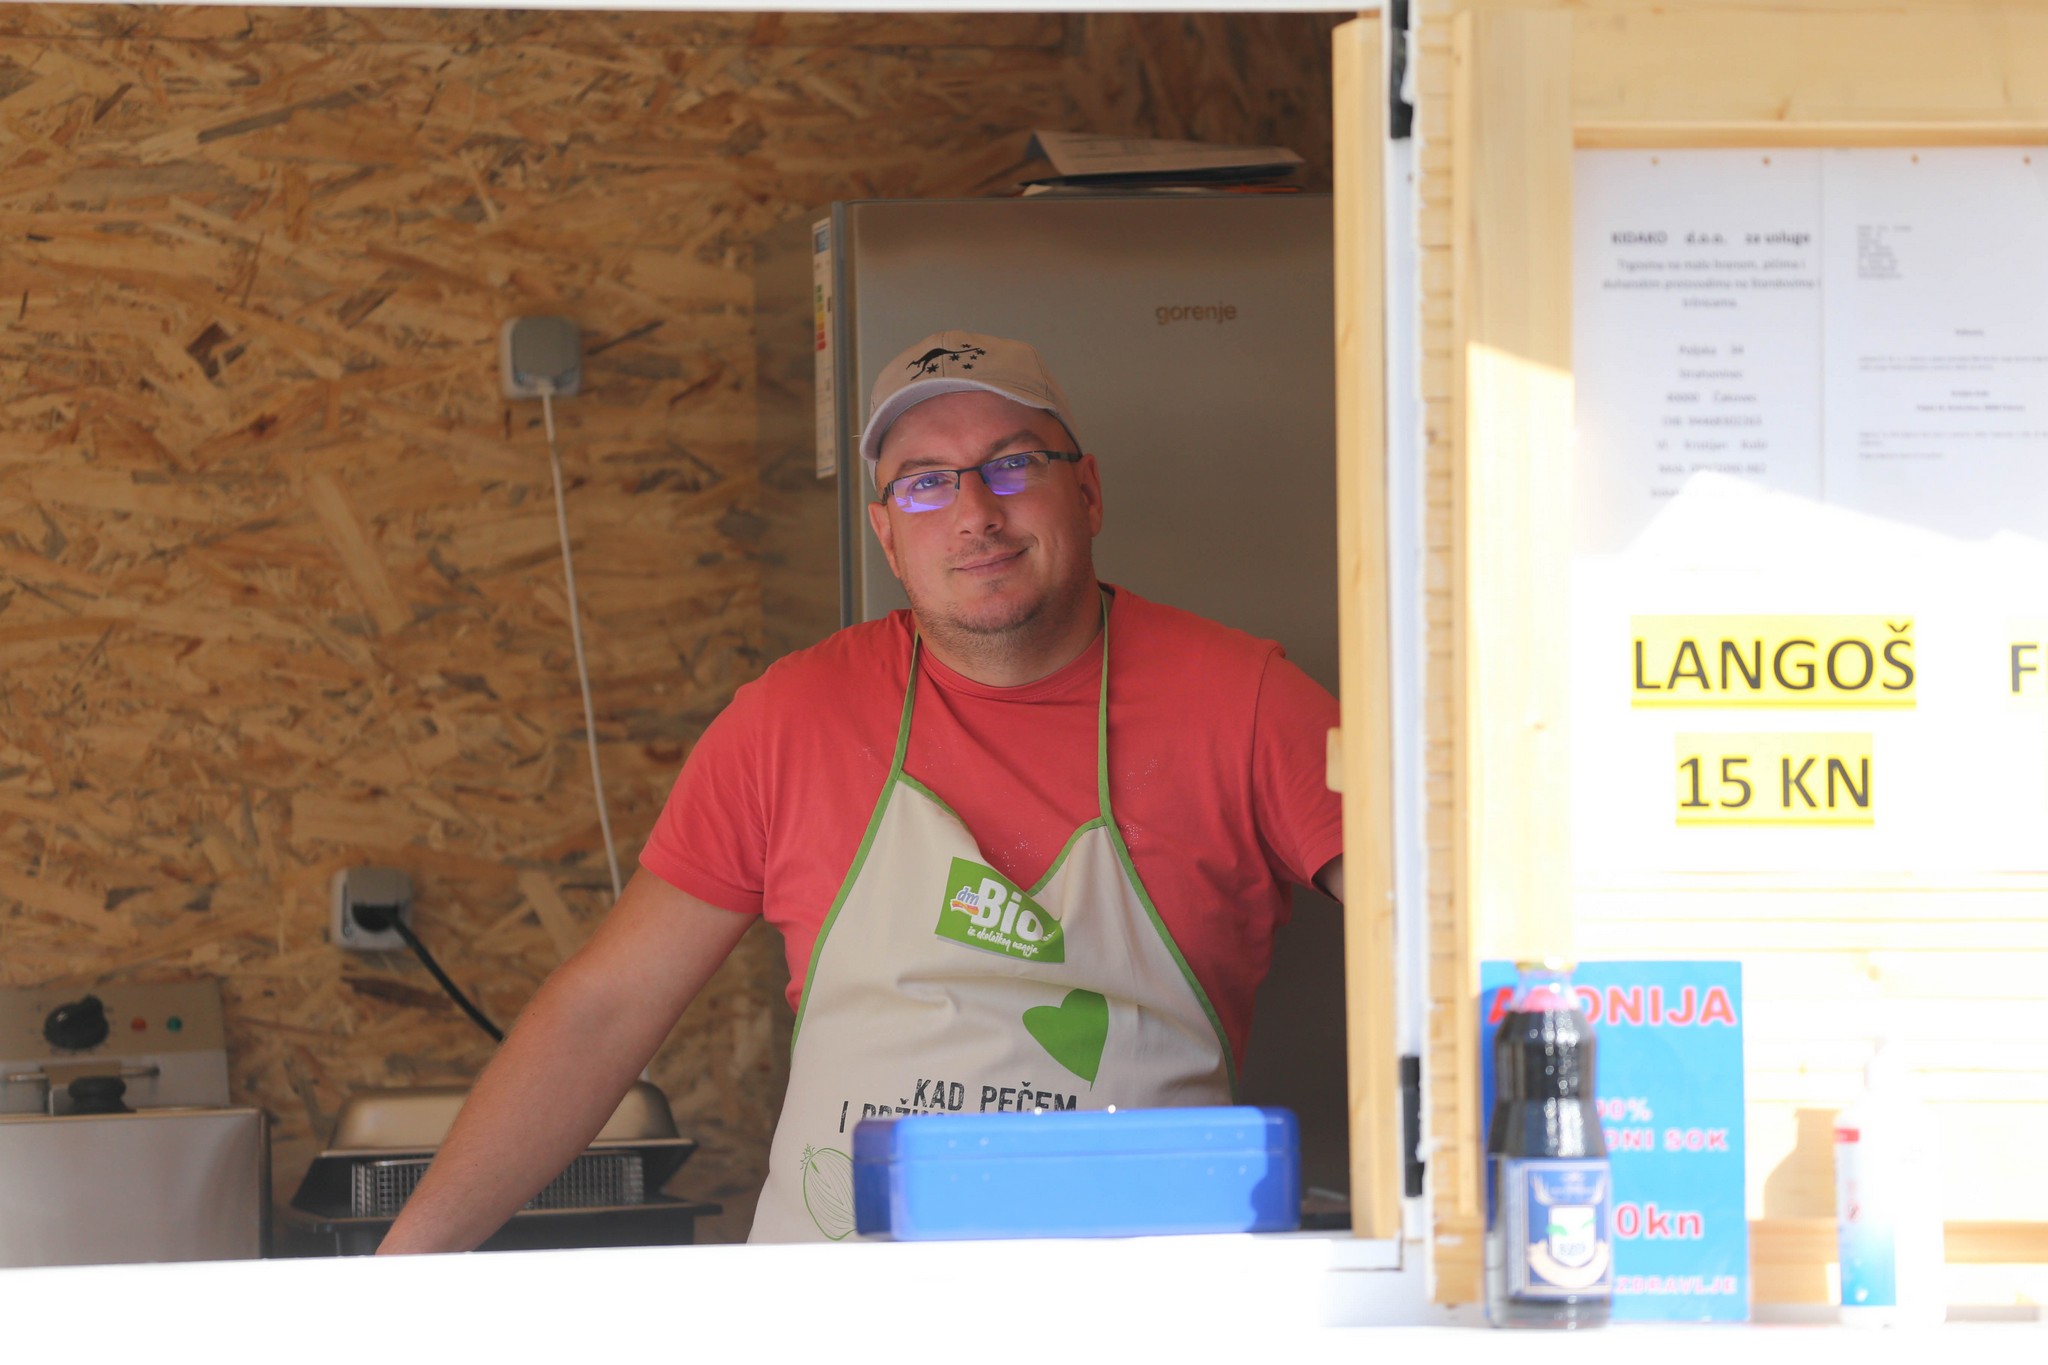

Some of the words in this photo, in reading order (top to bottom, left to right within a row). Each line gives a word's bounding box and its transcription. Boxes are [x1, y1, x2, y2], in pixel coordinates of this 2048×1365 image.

[1156, 302, 1237, 325] gorenje
[1635, 623, 1914, 691] LANGOŠ
[2011, 645, 2040, 692] F
[1679, 757, 1752, 808] 15
[1782, 757, 1869, 808] KN
[957, 886, 980, 906] dm
[971, 877, 1043, 941] Bio
[1488, 986, 1737, 1026] AONIJA
[913, 1078, 965, 1111] KAD
[980, 1081, 1077, 1114] PEČEM
[839, 1100, 849, 1133] I
[1664, 1128, 1728, 1151] SOK
[1615, 1202, 1703, 1238] 0kn
